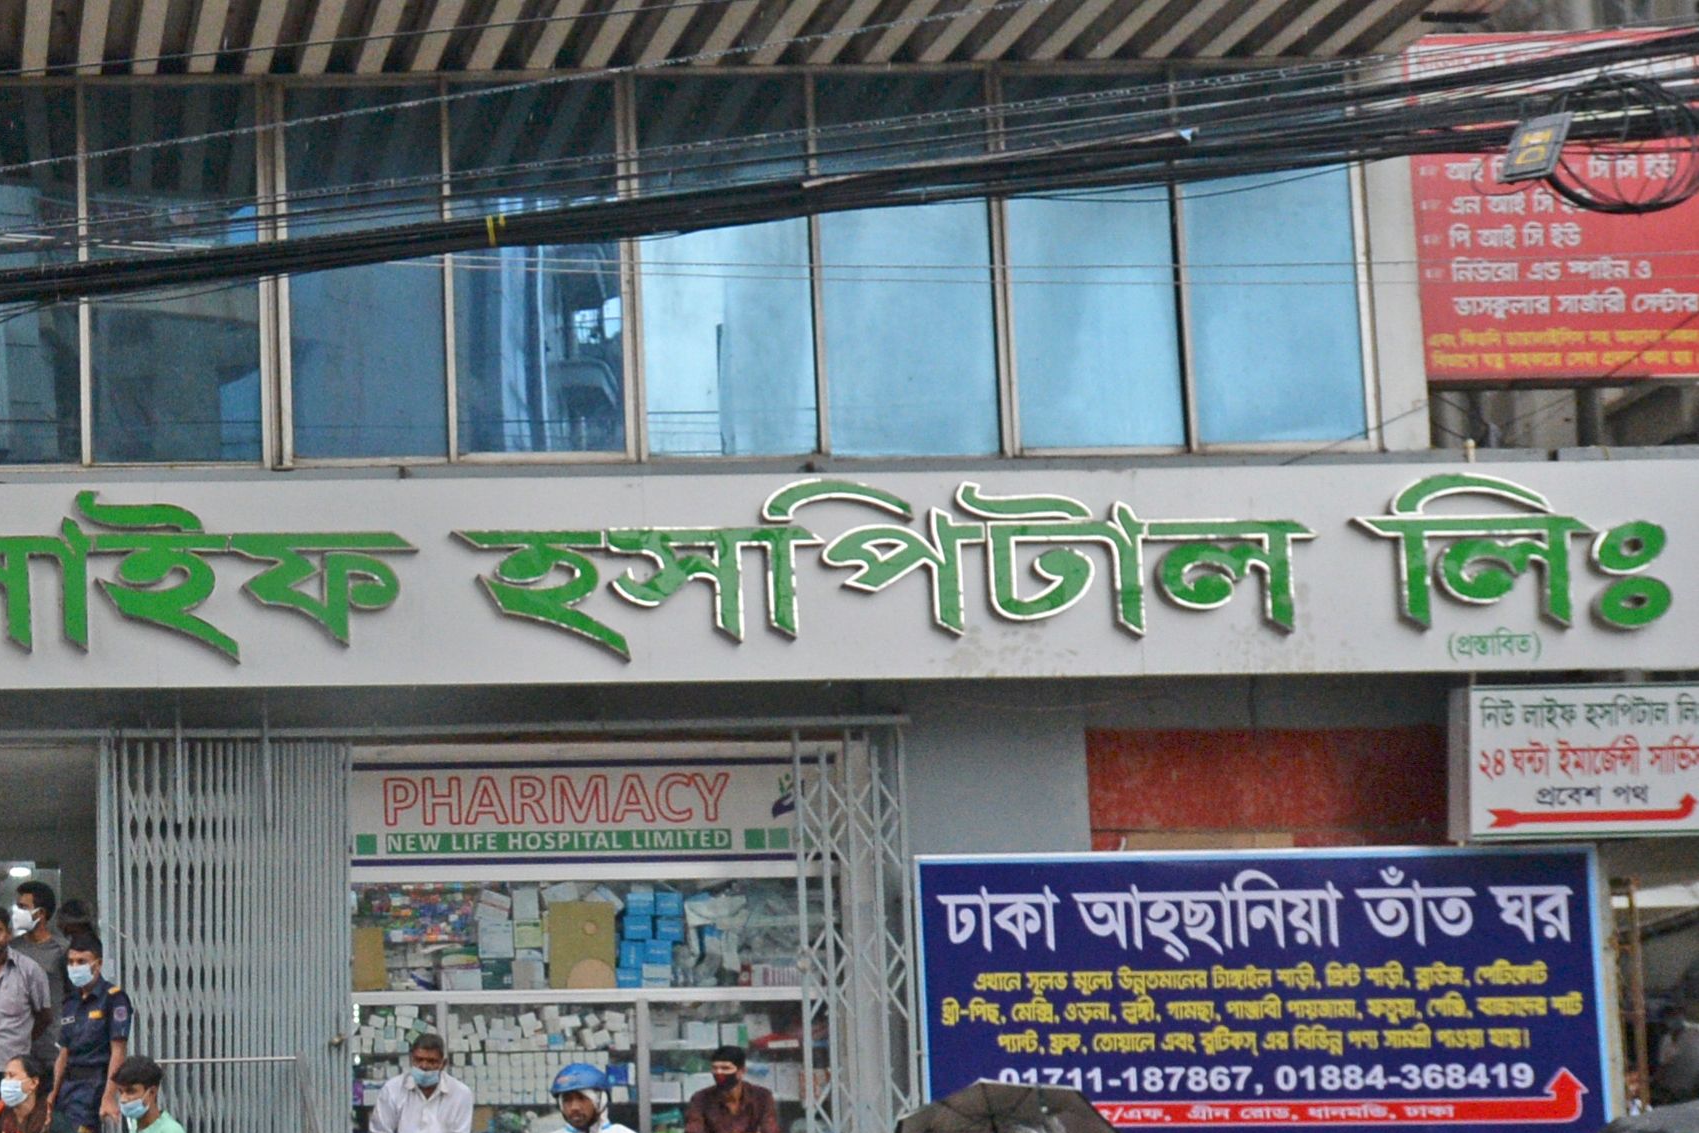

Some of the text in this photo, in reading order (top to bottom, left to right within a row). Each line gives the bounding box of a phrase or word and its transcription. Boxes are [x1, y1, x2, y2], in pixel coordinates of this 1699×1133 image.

[1449, 221, 1582, 249] পি আই সি ইউ
[1635, 261, 1653, 280] ও
[450, 478, 1319, 663] হসপিটাল
[1347, 473, 1673, 632] লিঃ
[1447, 627, 1542, 662] (প্রস্তাবিত)
[1479, 694, 1670, 729] নিউ লাইফ হসপিটাল
[1478, 748, 1506, 781] ২৪
[383, 772, 731, 827] PHARMACY
[1536, 783, 1650, 807] প্রবেশ পথ
[386, 830, 730, 853] NEW LIFE HOSPITAL LIMITED
[936, 865, 1574, 961] ঢাকা আহ্ছানিয়া তাঁত ঘর
[973, 970, 1022, 992] এখানে
[1161, 1032, 1196, 1054] এবং
[1263, 1030, 1290, 1050] এর
[1275, 1063, 1535, 1091] 01884-368419
